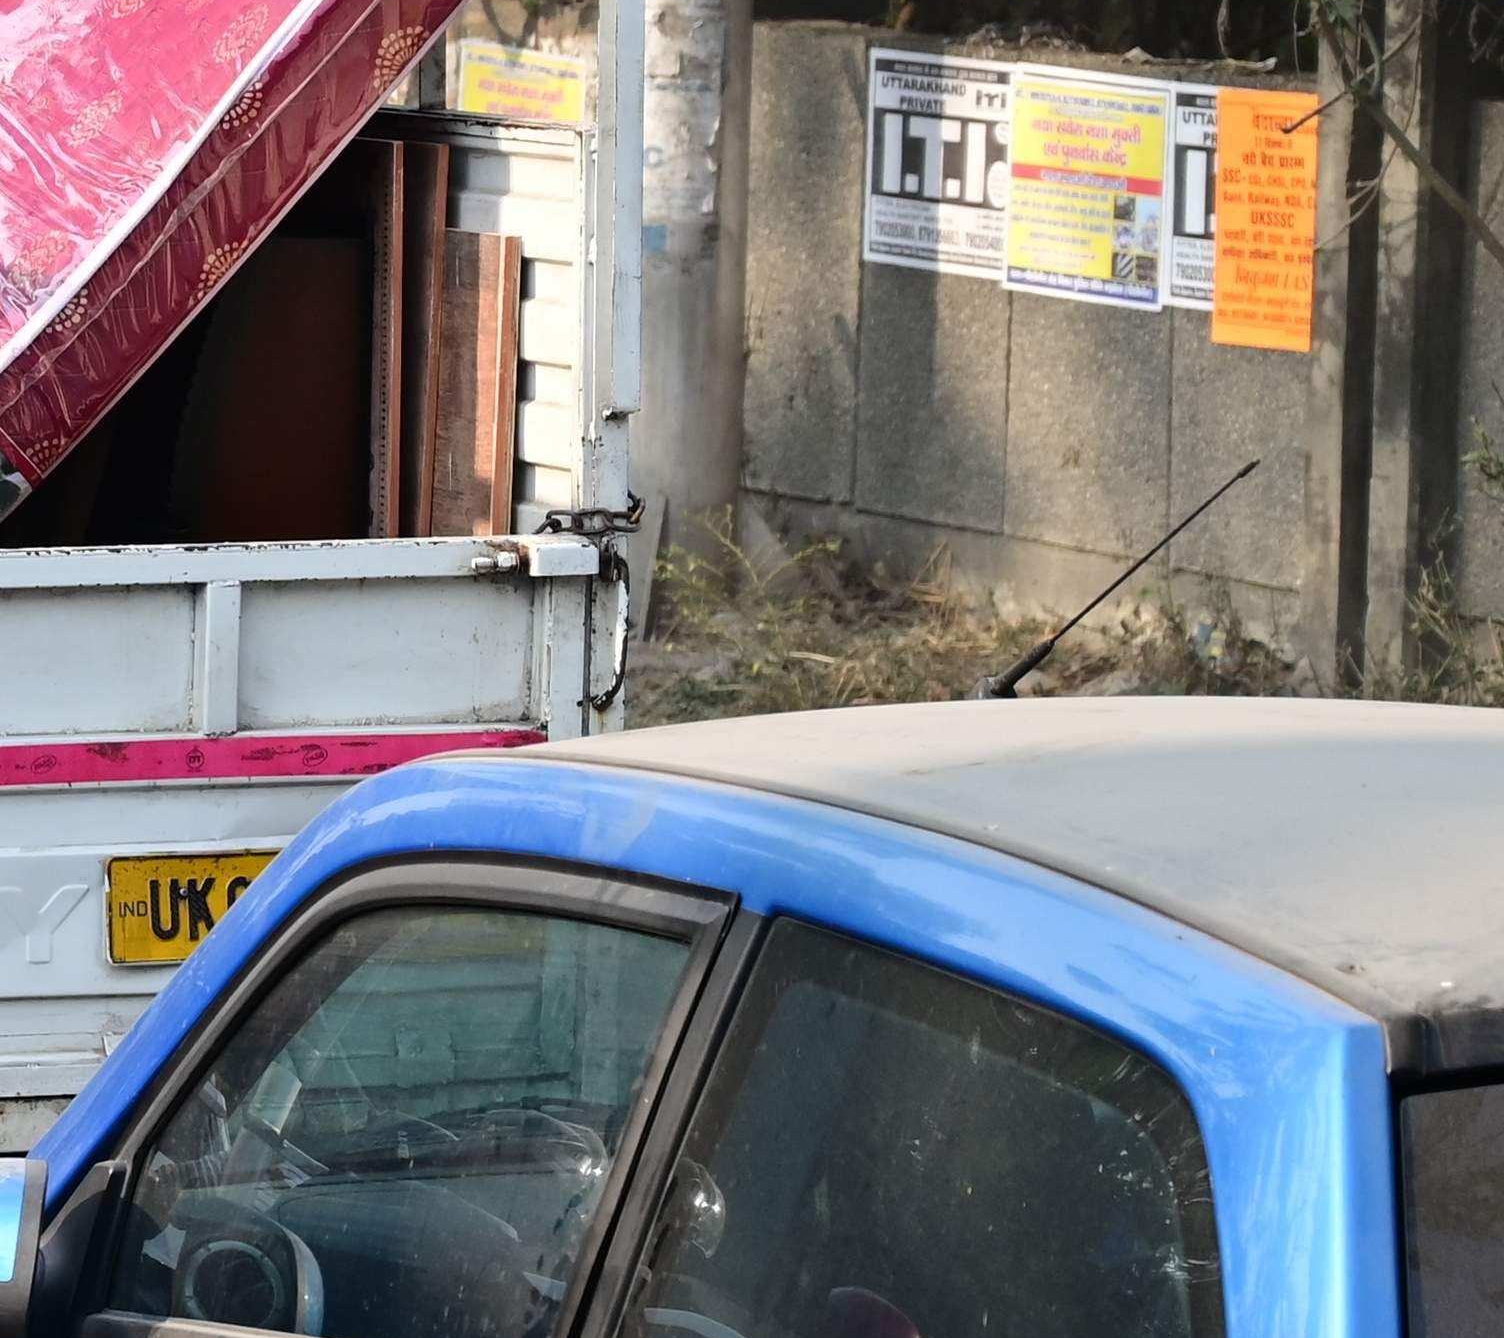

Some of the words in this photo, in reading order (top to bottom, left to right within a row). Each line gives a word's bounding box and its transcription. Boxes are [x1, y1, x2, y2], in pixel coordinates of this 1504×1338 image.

[881, 75, 968, 97] UTTARAKHAND
[1182, 110, 1217, 127] UTTA
[1250, 210, 1295, 228] UKSSSC
[119, 900, 148, 918] IND
